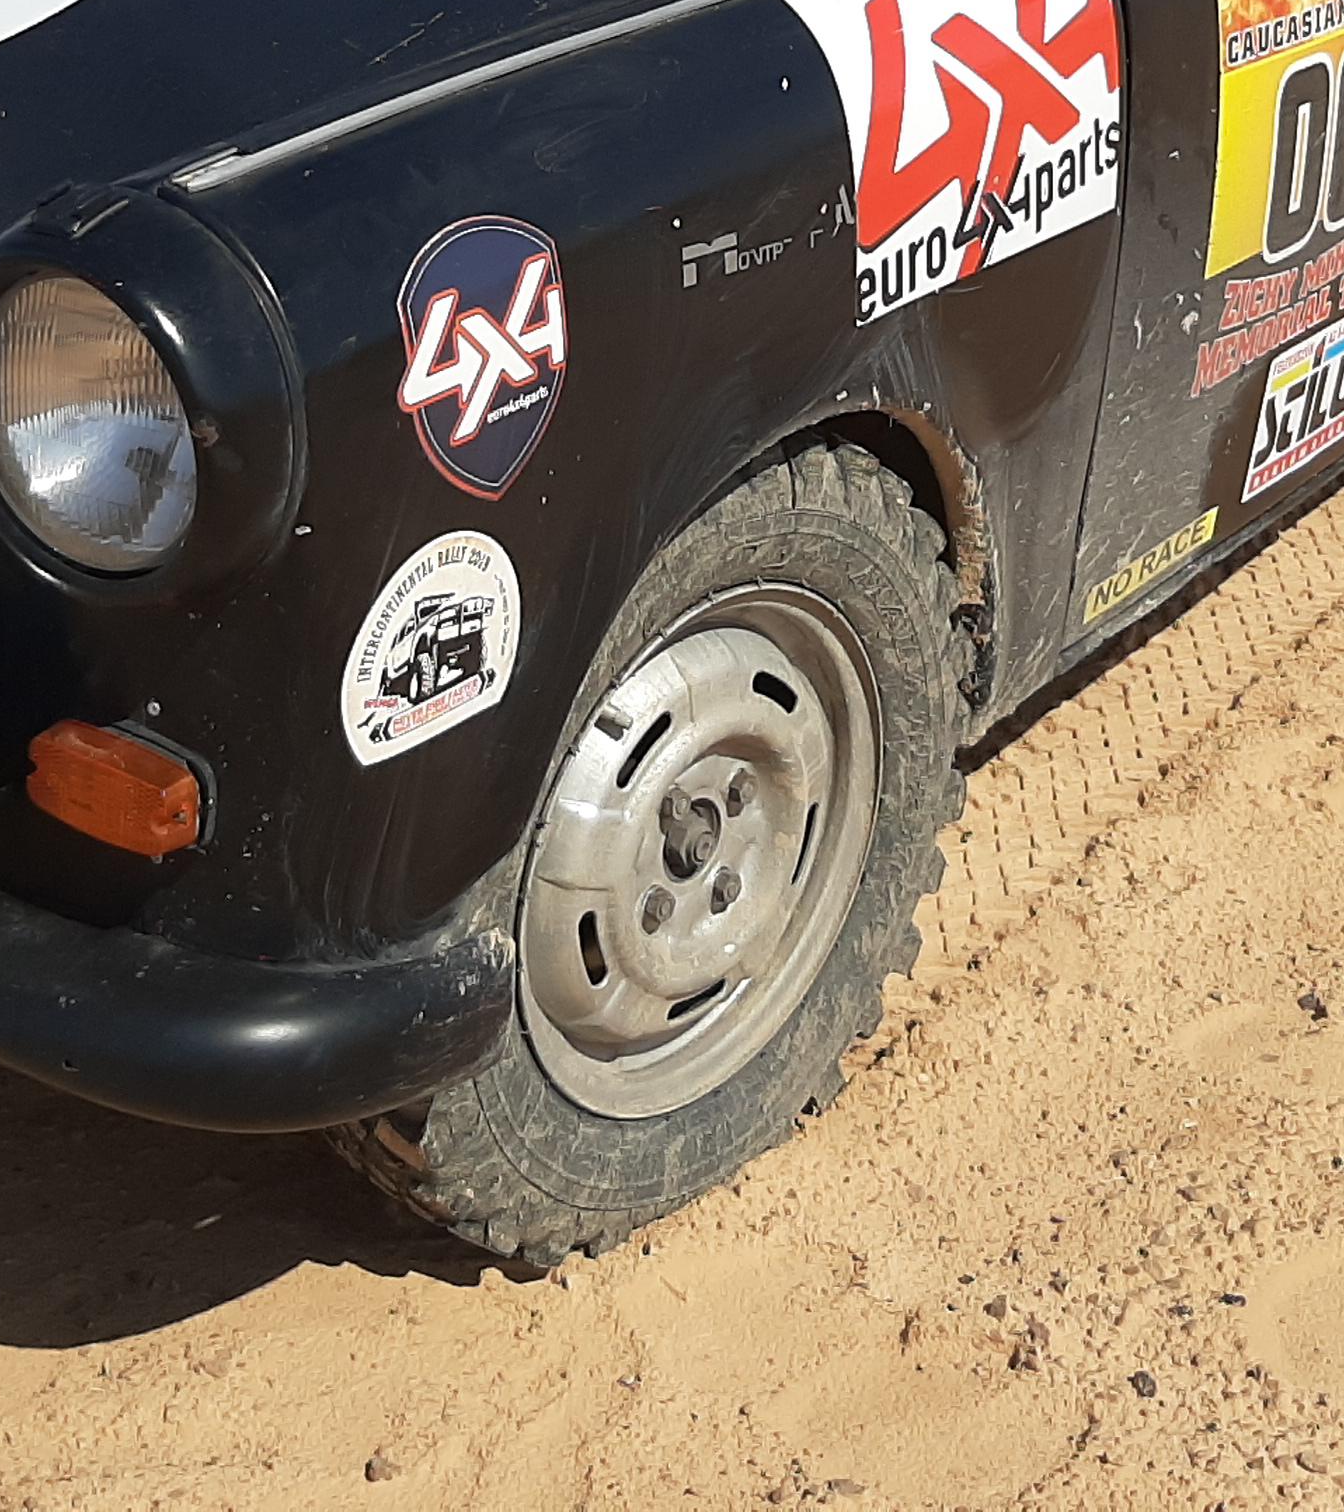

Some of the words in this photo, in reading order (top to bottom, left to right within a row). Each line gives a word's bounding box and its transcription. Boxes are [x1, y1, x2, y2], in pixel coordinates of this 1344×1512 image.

[856, 118, 1122, 322] euro4x4parts
[398, 252, 567, 447] 4x4
[1190, 285, 1333, 399] MEMORIAL
[1218, 267, 1299, 331] ZICHY
[357, 557, 434, 683] INTERCONTINENTAL
[1092, 568, 1133, 611] NO
[1139, 515, 1208, 581] RACE
